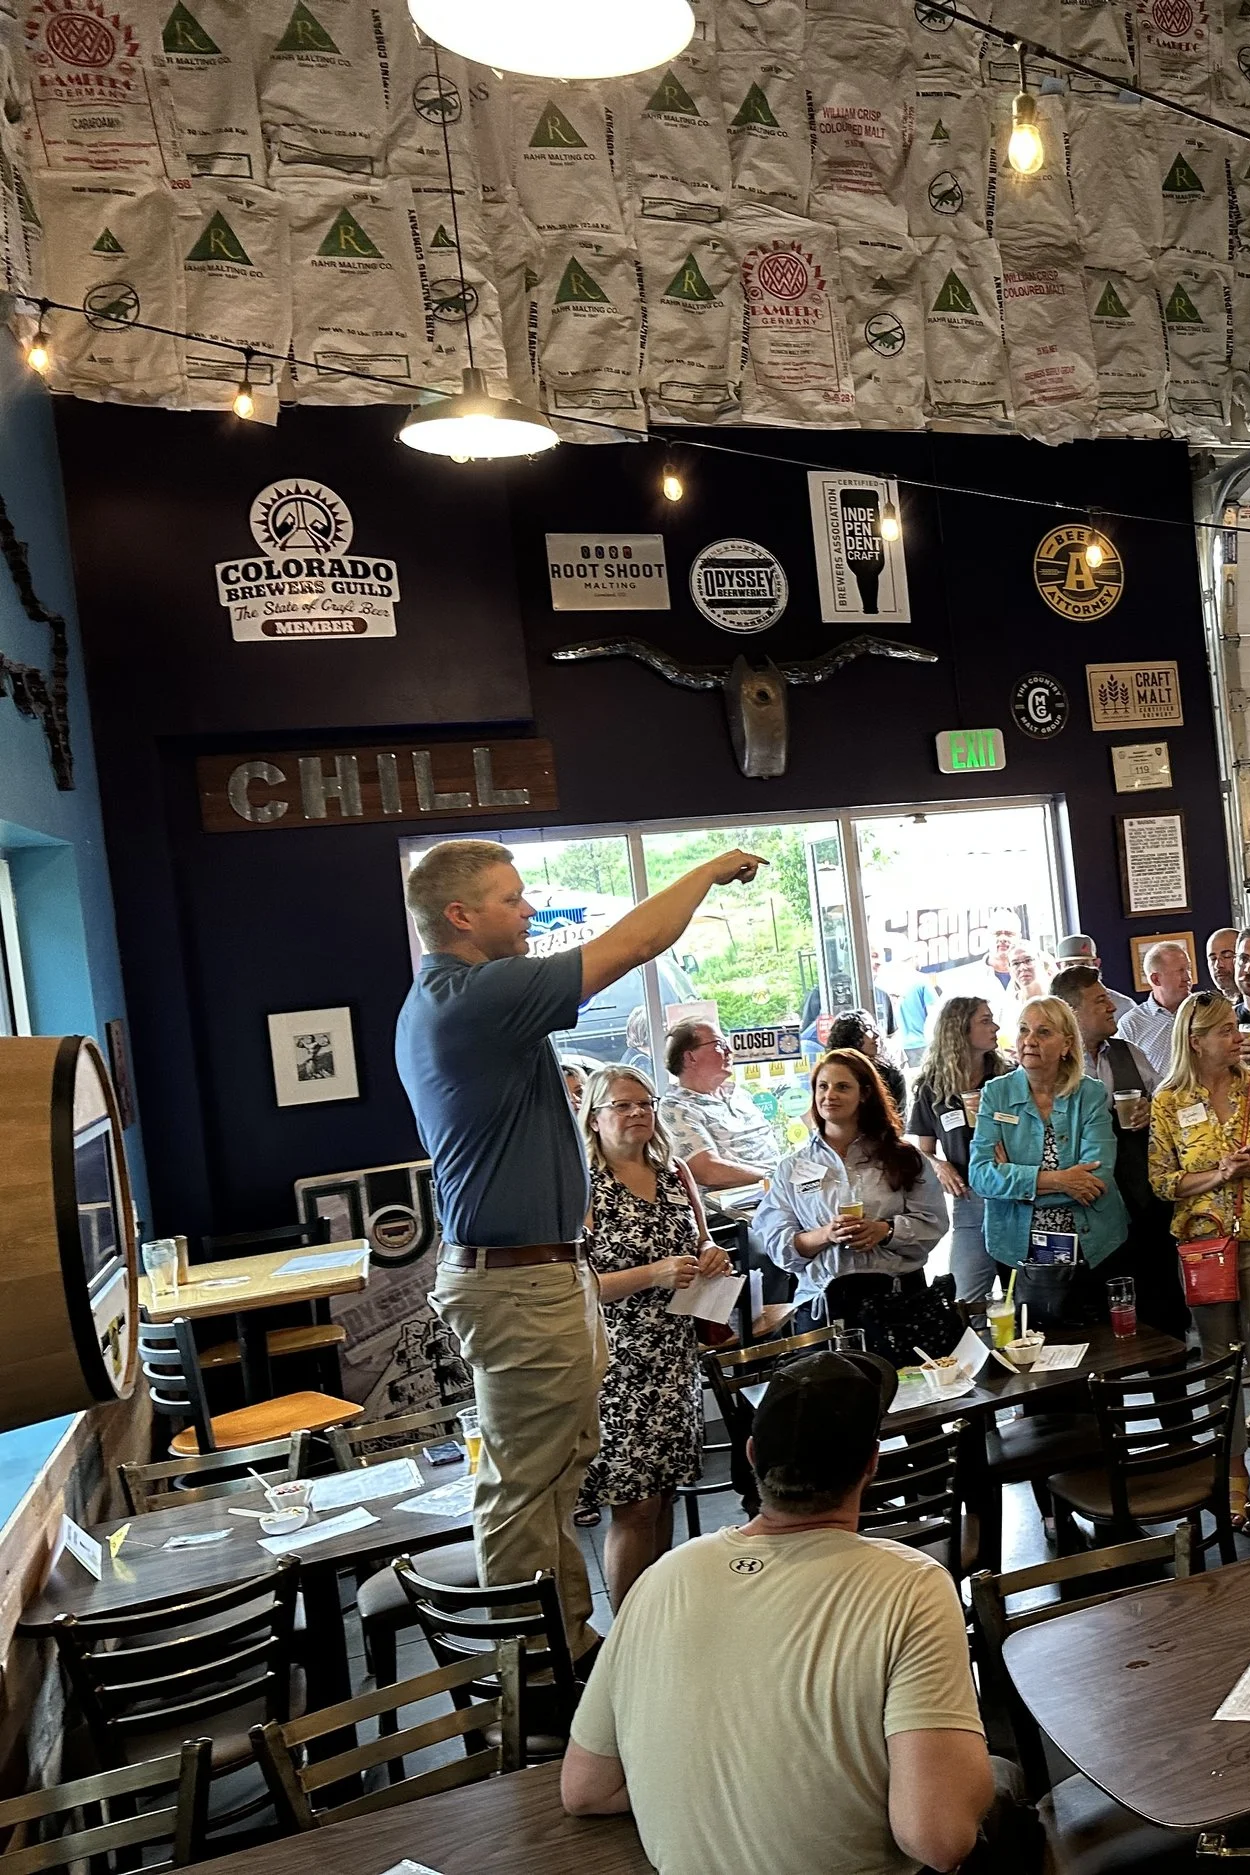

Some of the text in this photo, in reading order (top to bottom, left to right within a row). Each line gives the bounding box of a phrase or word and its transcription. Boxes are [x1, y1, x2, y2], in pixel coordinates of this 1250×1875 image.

[371, 8, 388, 60] COMPANY
[297, 55, 333, 65] MALTING
[55, 88, 128, 98] GERMANY
[663, 114, 695, 125] MALTING
[822, 107, 882, 121] WILLIAM CRISP
[865, 126, 886, 139] MALT
[987, 174, 996, 217] MALTING
[408, 209, 425, 261] COMPANY
[208, 264, 247, 277] MALTING
[311, 260, 336, 268] RAHR
[338, 261, 378, 270] MALTING
[1036, 271, 1059, 281] CRISP
[417, 263, 434, 313] MALTING
[1003, 285, 1046, 299] COLOURED
[571, 305, 605, 314] MALTING
[1223, 285, 1231, 325] COMPANY
[741, 305, 751, 346] MALTING
[761, 317, 817, 325] GERMANY
[838, 479, 879, 487] CERTIFIED
[843, 507, 874, 522] INDE
[844, 522, 872, 536] PEN
[846, 537, 882, 551] DENT
[1054, 531, 1089, 546] BEE
[827, 488, 848, 607] BREWERS ASSOCIATION
[847, 551, 880, 561] CRAFT
[220, 558, 394, 586] COLORADO
[550, 564, 664, 578] ROOT SHOOT
[704, 570, 774, 597] ODYSSEY
[225, 581, 393, 602] BREWERS GUILD
[717, 588, 767, 597] BEERWERKS
[1047, 589, 1113, 614] ATTORNEY
[234, 598, 390, 622] The State of Craft Beer
[275, 620, 356, 634] MEMBER
[1135, 671, 1170, 687] CRAFT
[1017, 676, 1062, 698] THE COUNTRY
[1137, 688, 1172, 704] MALT
[1020, 714, 1062, 734] MALT GROUP
[950, 732, 996, 769] EXIT
[228, 747, 530, 823] CHILL
[733, 1032, 775, 1050] CLOSED
